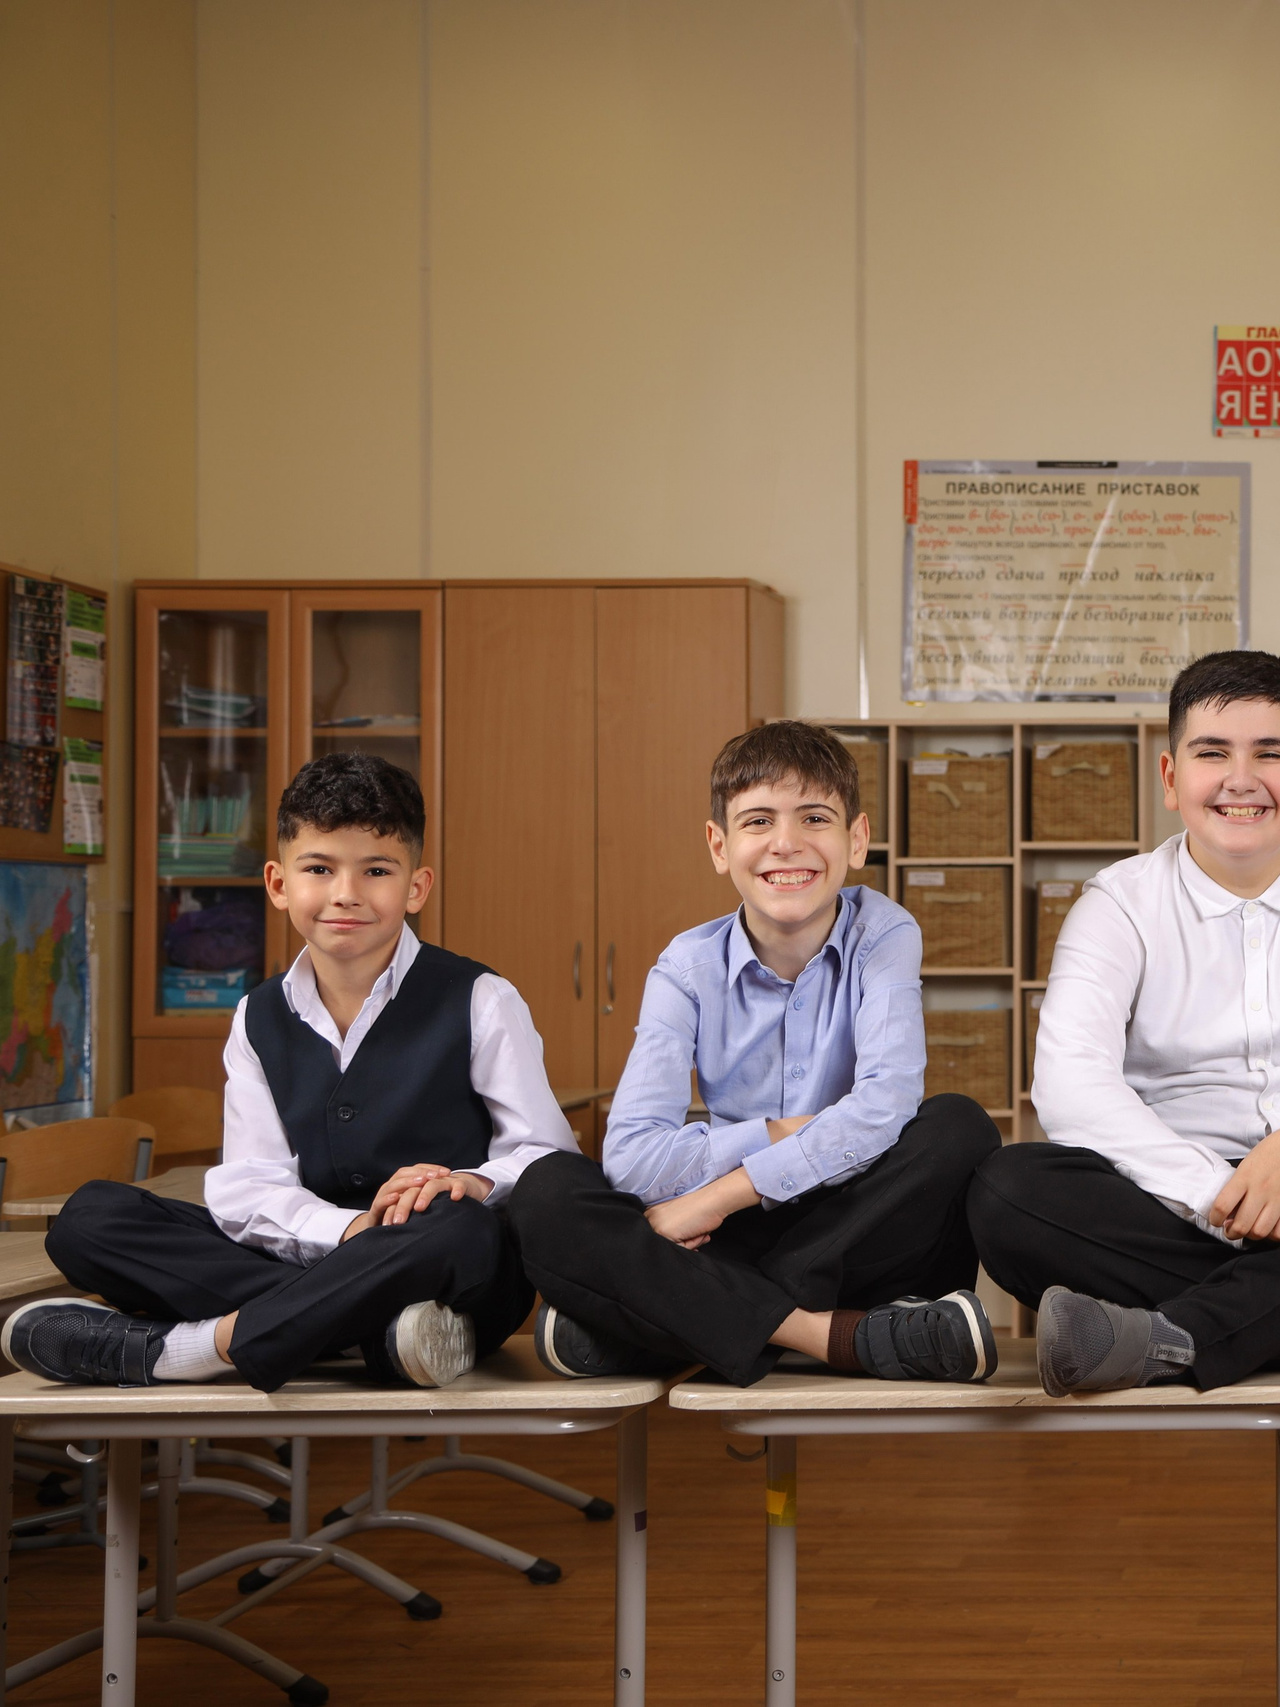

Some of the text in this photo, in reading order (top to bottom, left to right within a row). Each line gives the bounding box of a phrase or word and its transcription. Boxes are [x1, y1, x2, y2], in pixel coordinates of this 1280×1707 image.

[945, 481, 1200, 497] ПРАВОПИСАНИЕ ПРИСТАВОК
[1157, 1349, 1185, 1359] adidas
